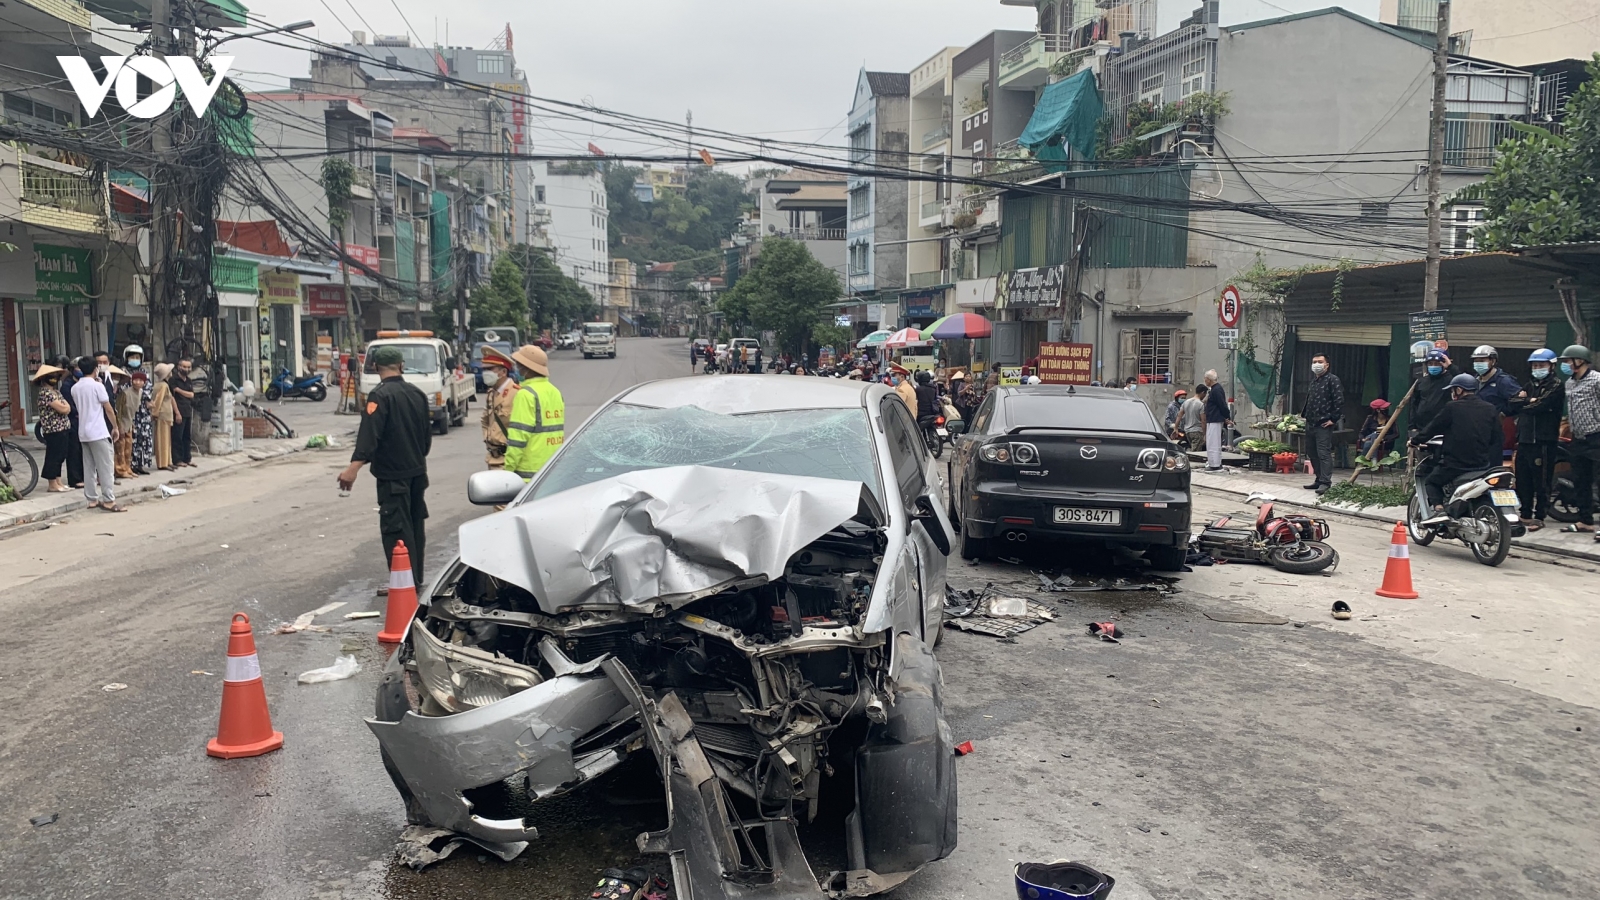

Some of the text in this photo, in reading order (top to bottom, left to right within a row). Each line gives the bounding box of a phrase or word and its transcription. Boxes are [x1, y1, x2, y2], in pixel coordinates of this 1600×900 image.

[1041, 344, 1091, 359] TUYẾN ĐƯỜNG SẠCH ĐẸP
[1040, 358, 1090, 370] AN TOÀN GIAO THÔNG
